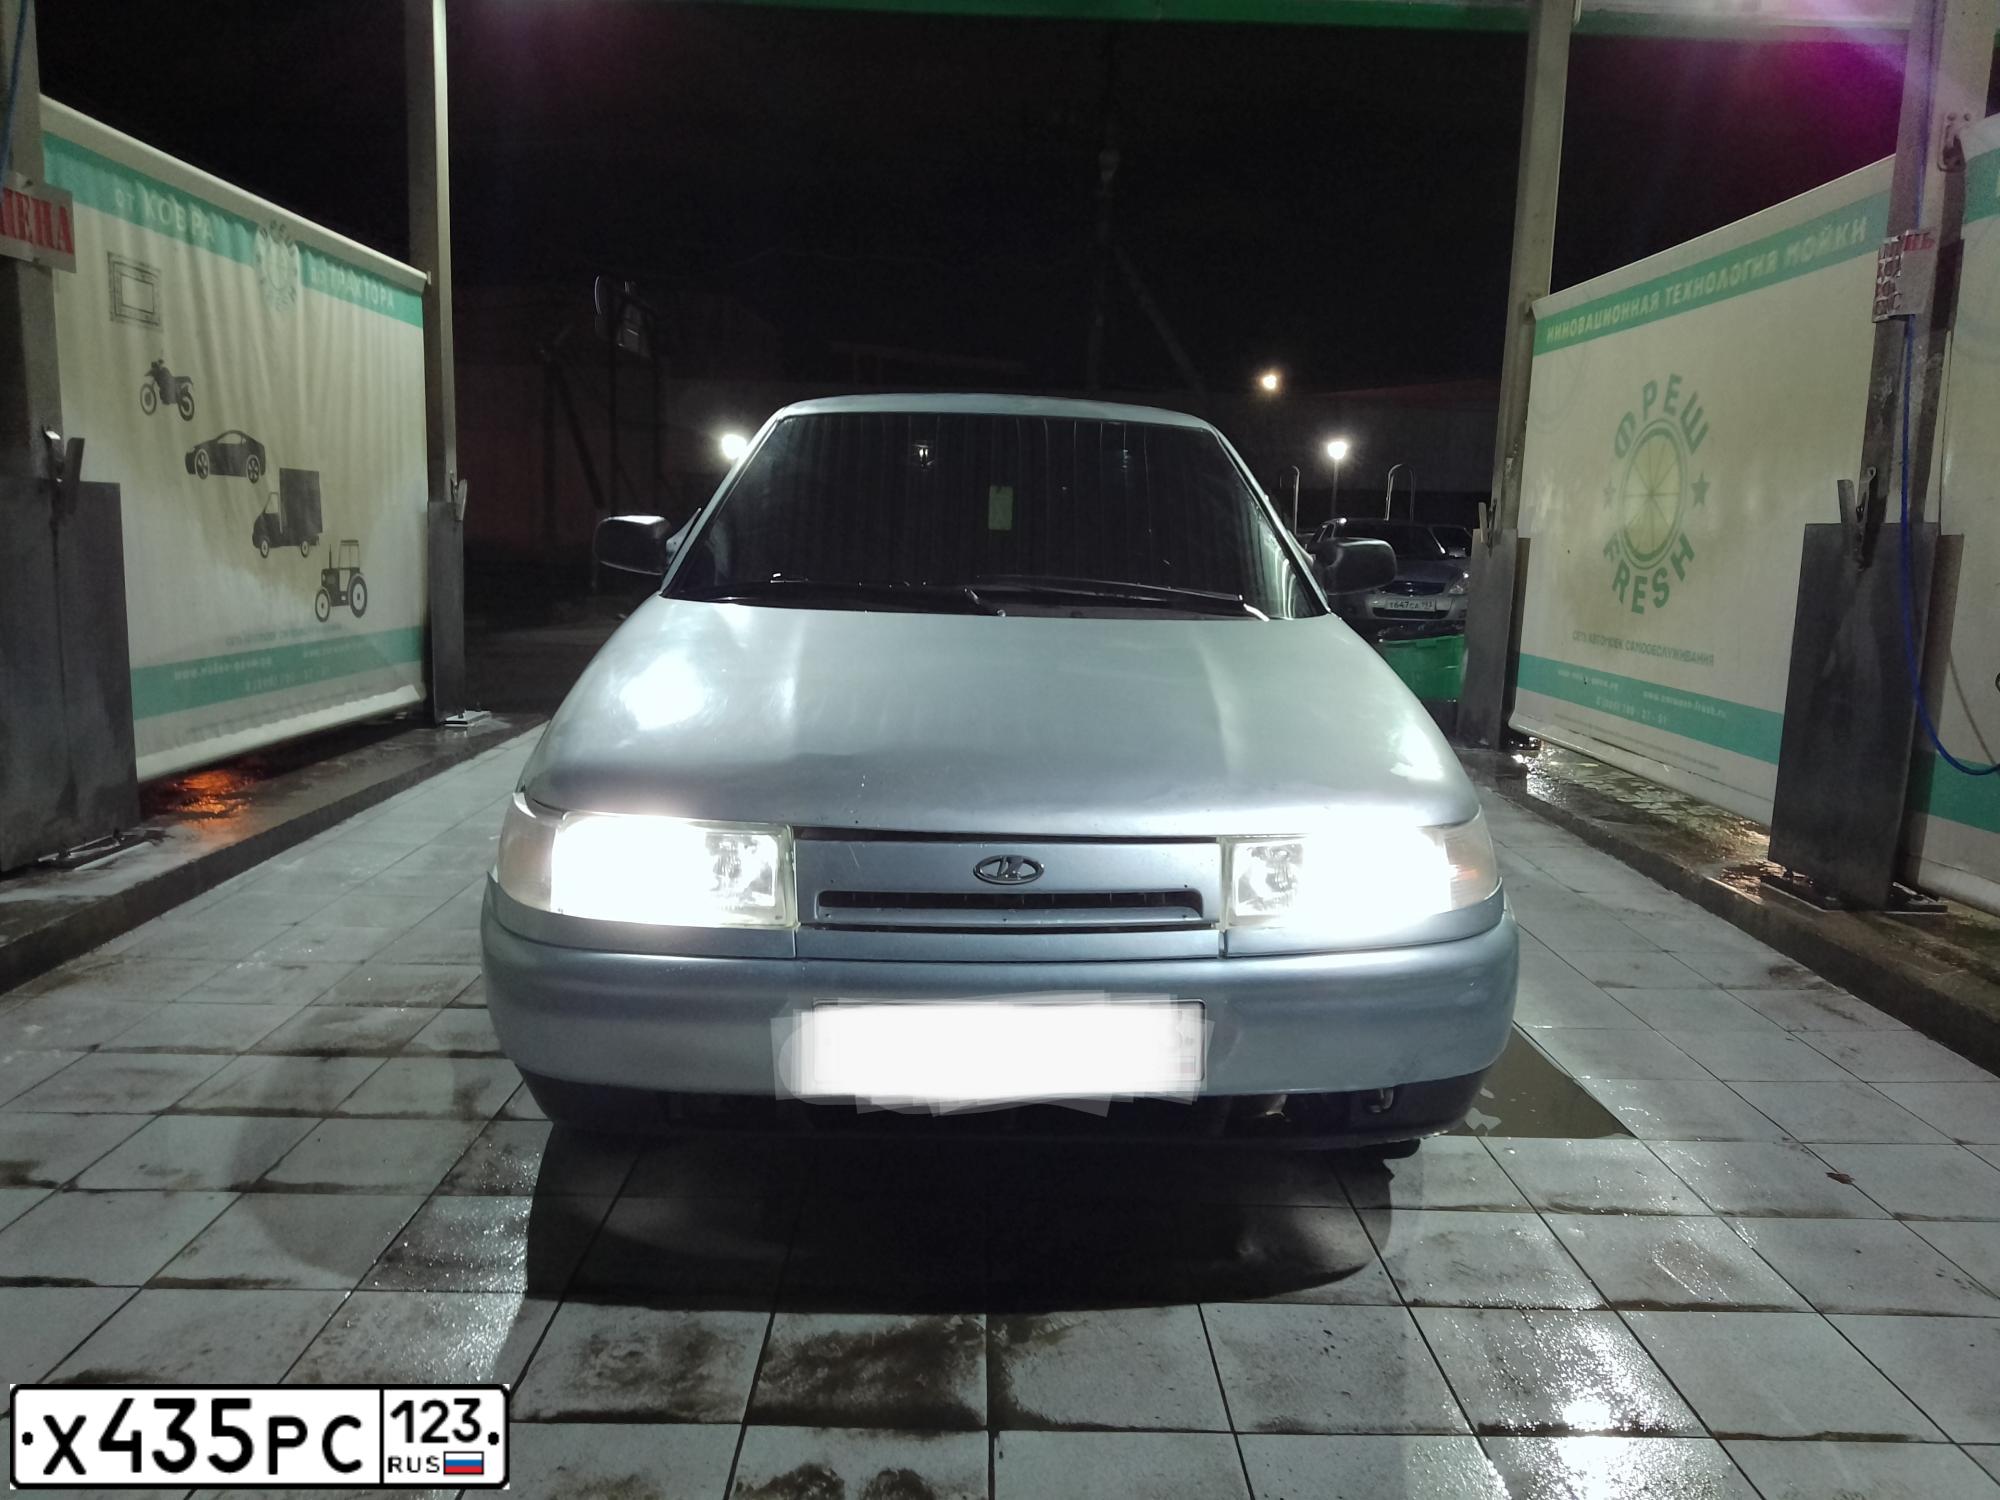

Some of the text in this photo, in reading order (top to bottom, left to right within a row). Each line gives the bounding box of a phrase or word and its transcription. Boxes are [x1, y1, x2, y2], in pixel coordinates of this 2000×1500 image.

[1546, 216, 1868, 343] ИННОВАЦИОННАЯ ТЕХНОЛОГИЯ МОЙКИ
[1614, 372, 1709, 457] ФРЕШ
[1602, 532, 1696, 615] FRESH
